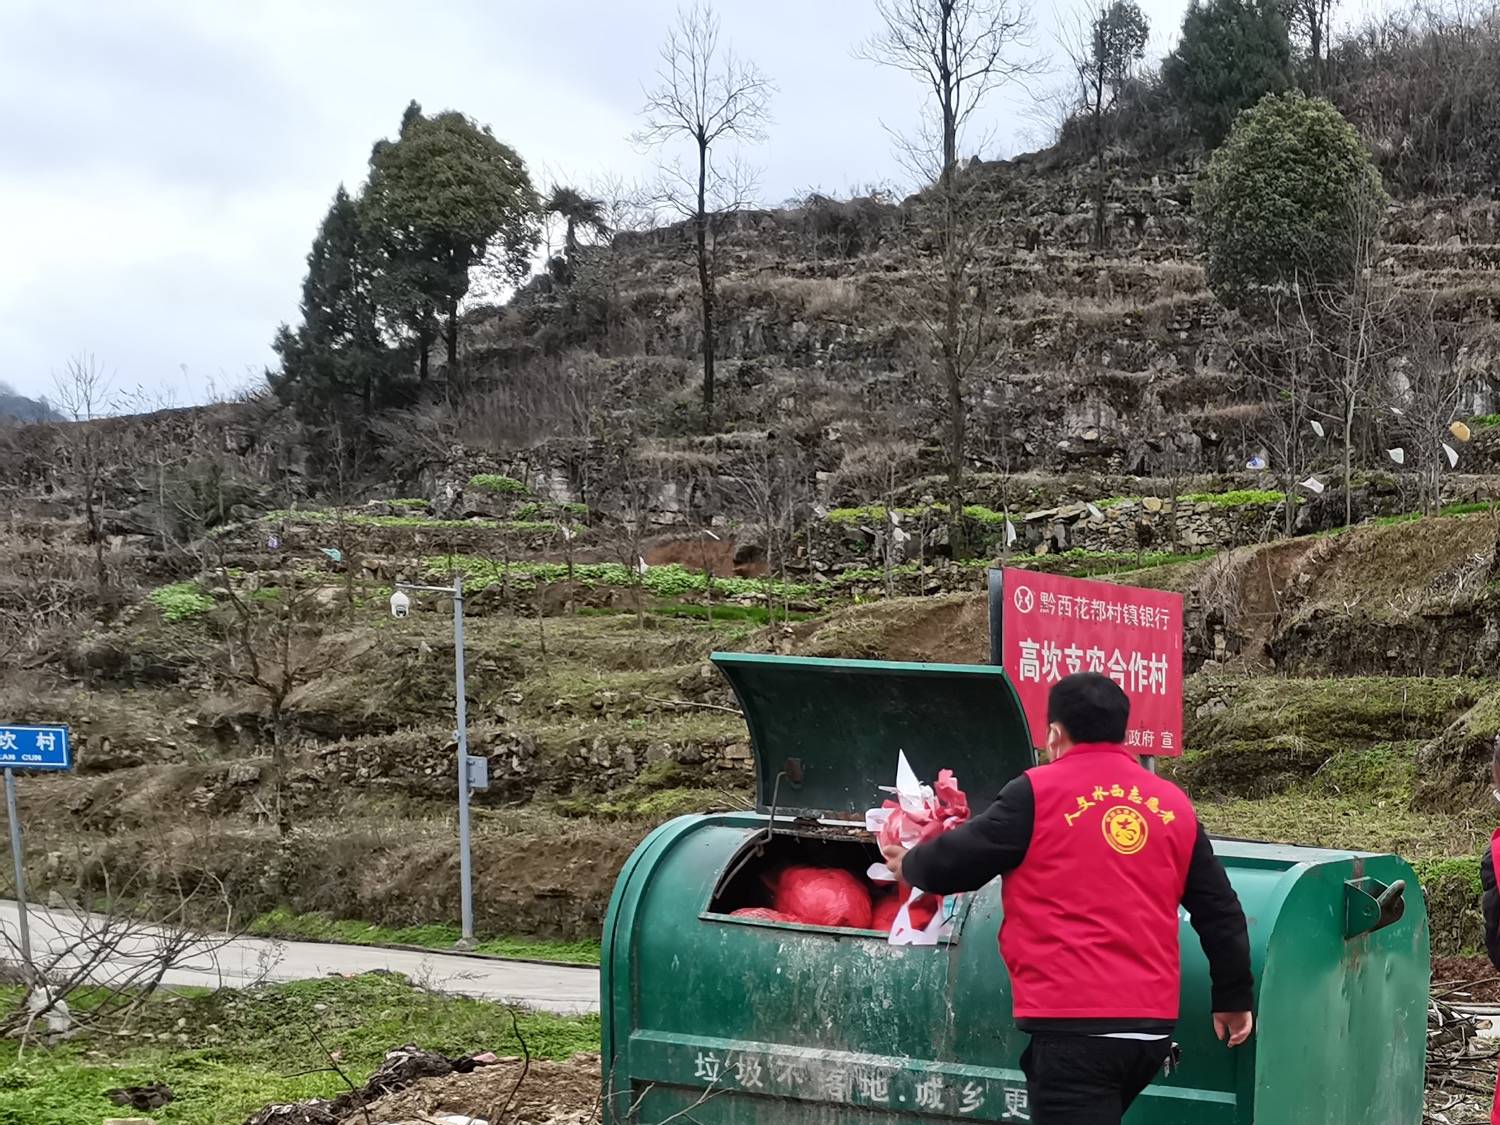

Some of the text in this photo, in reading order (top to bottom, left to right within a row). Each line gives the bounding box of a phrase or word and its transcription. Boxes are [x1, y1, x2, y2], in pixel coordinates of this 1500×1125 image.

[1039, 591, 1171, 631] 黔西花都村镇银行
[1124, 729, 1155, 748] 政府
